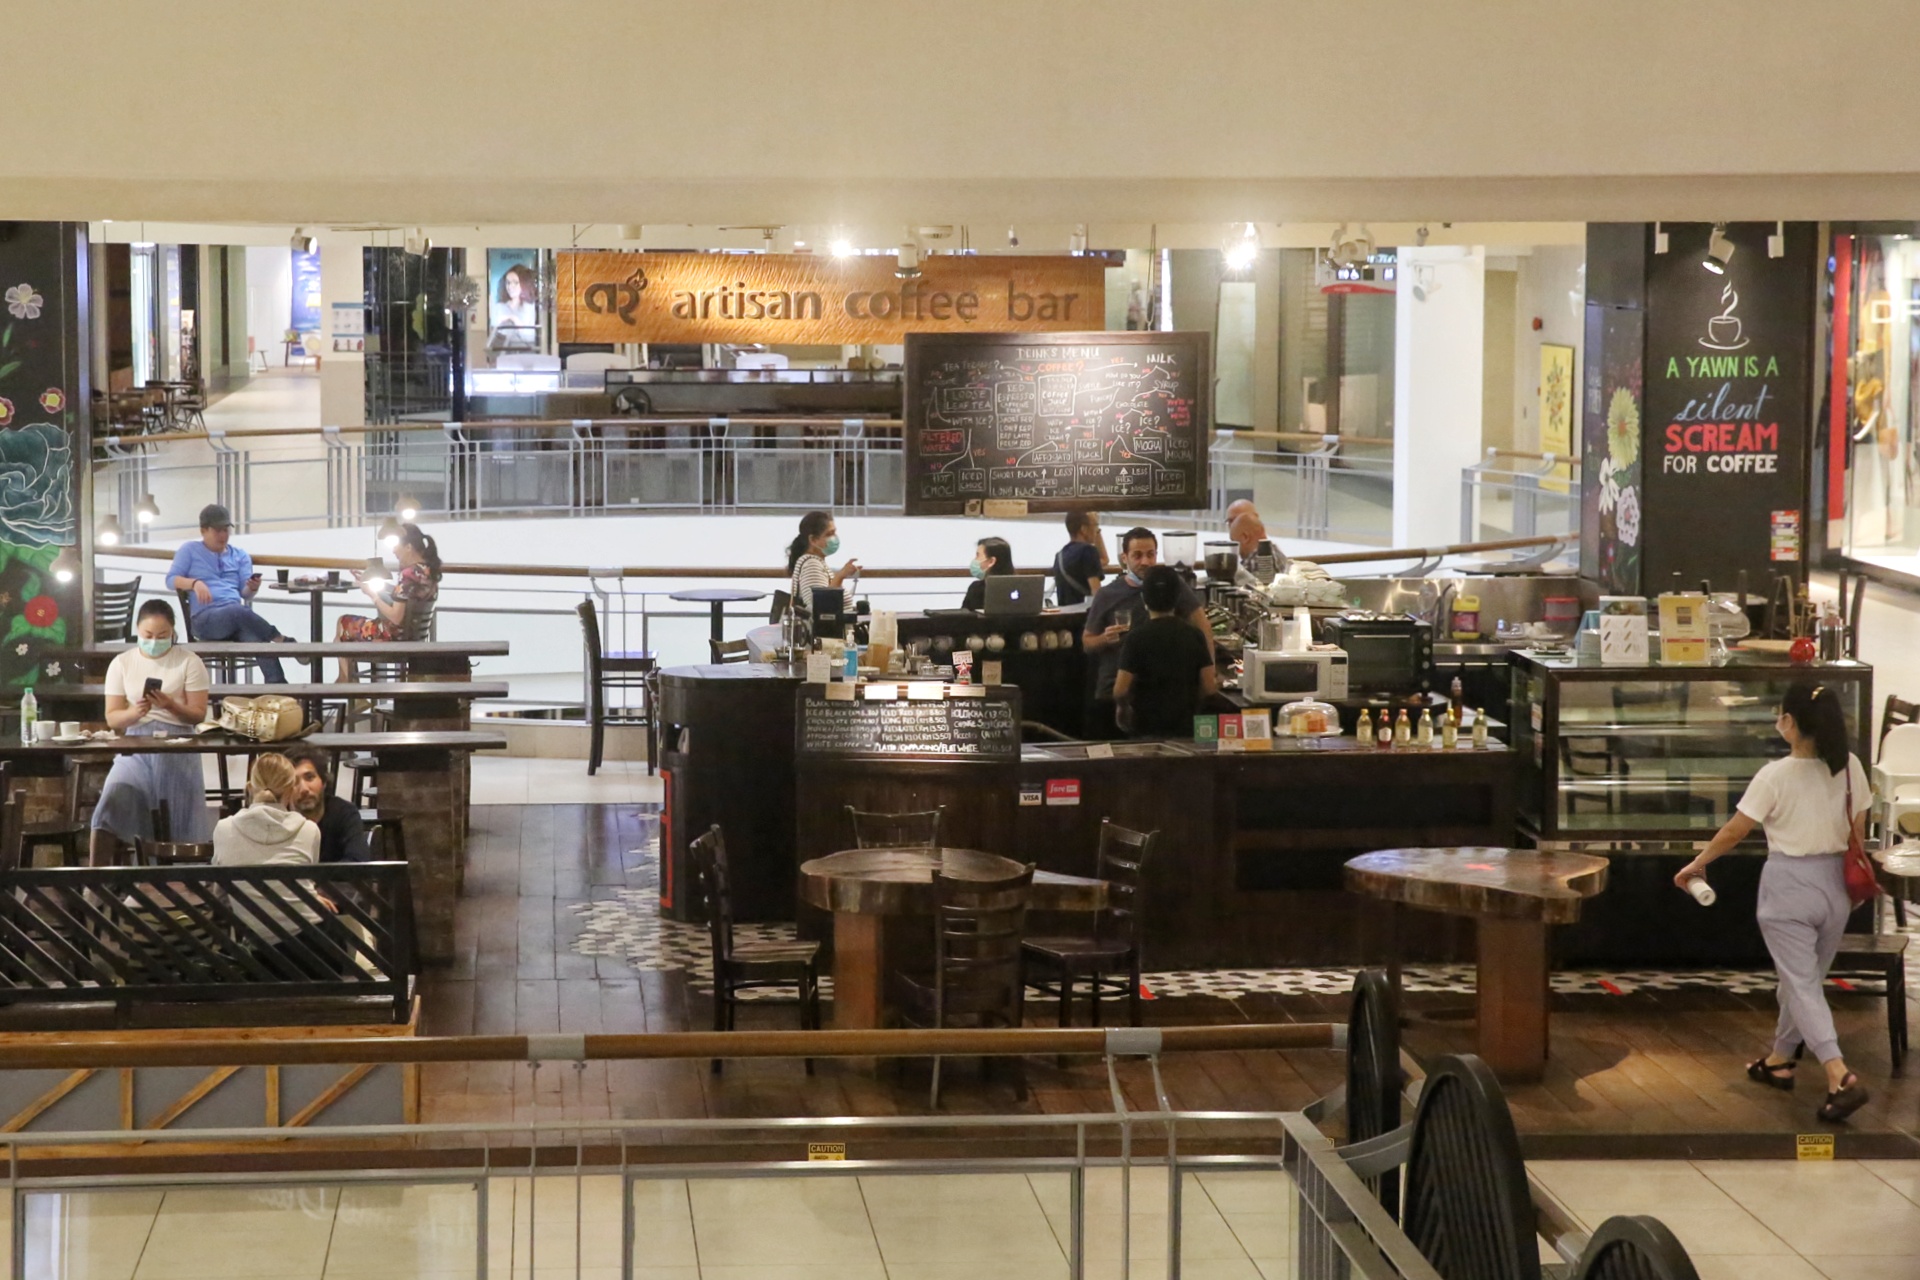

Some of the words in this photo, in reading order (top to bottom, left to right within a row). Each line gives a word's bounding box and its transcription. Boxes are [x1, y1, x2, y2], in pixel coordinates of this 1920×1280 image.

[671, 281, 822, 320] artisan
[844, 280, 980, 321] coffee
[1007, 280, 1079, 321] bar
[1063, 347, 1101, 359] MENU
[1146, 353, 1176, 365] MILK
[1666, 356, 1680, 379] A
[1686, 356, 1739, 378] YAWN
[1744, 356, 1759, 377] IS
[1765, 355, 1779, 377] A
[1672, 382, 1775, 421] silent
[1664, 422, 1778, 453] SCREAM
[1663, 455, 1697, 473] FOR
[1706, 454, 1778, 473] COFFEE
[1022, 794, 1040, 802] VISA
[1800, 1135, 1832, 1144] CAUTION
[810, 1145, 844, 1153] CAUTION
